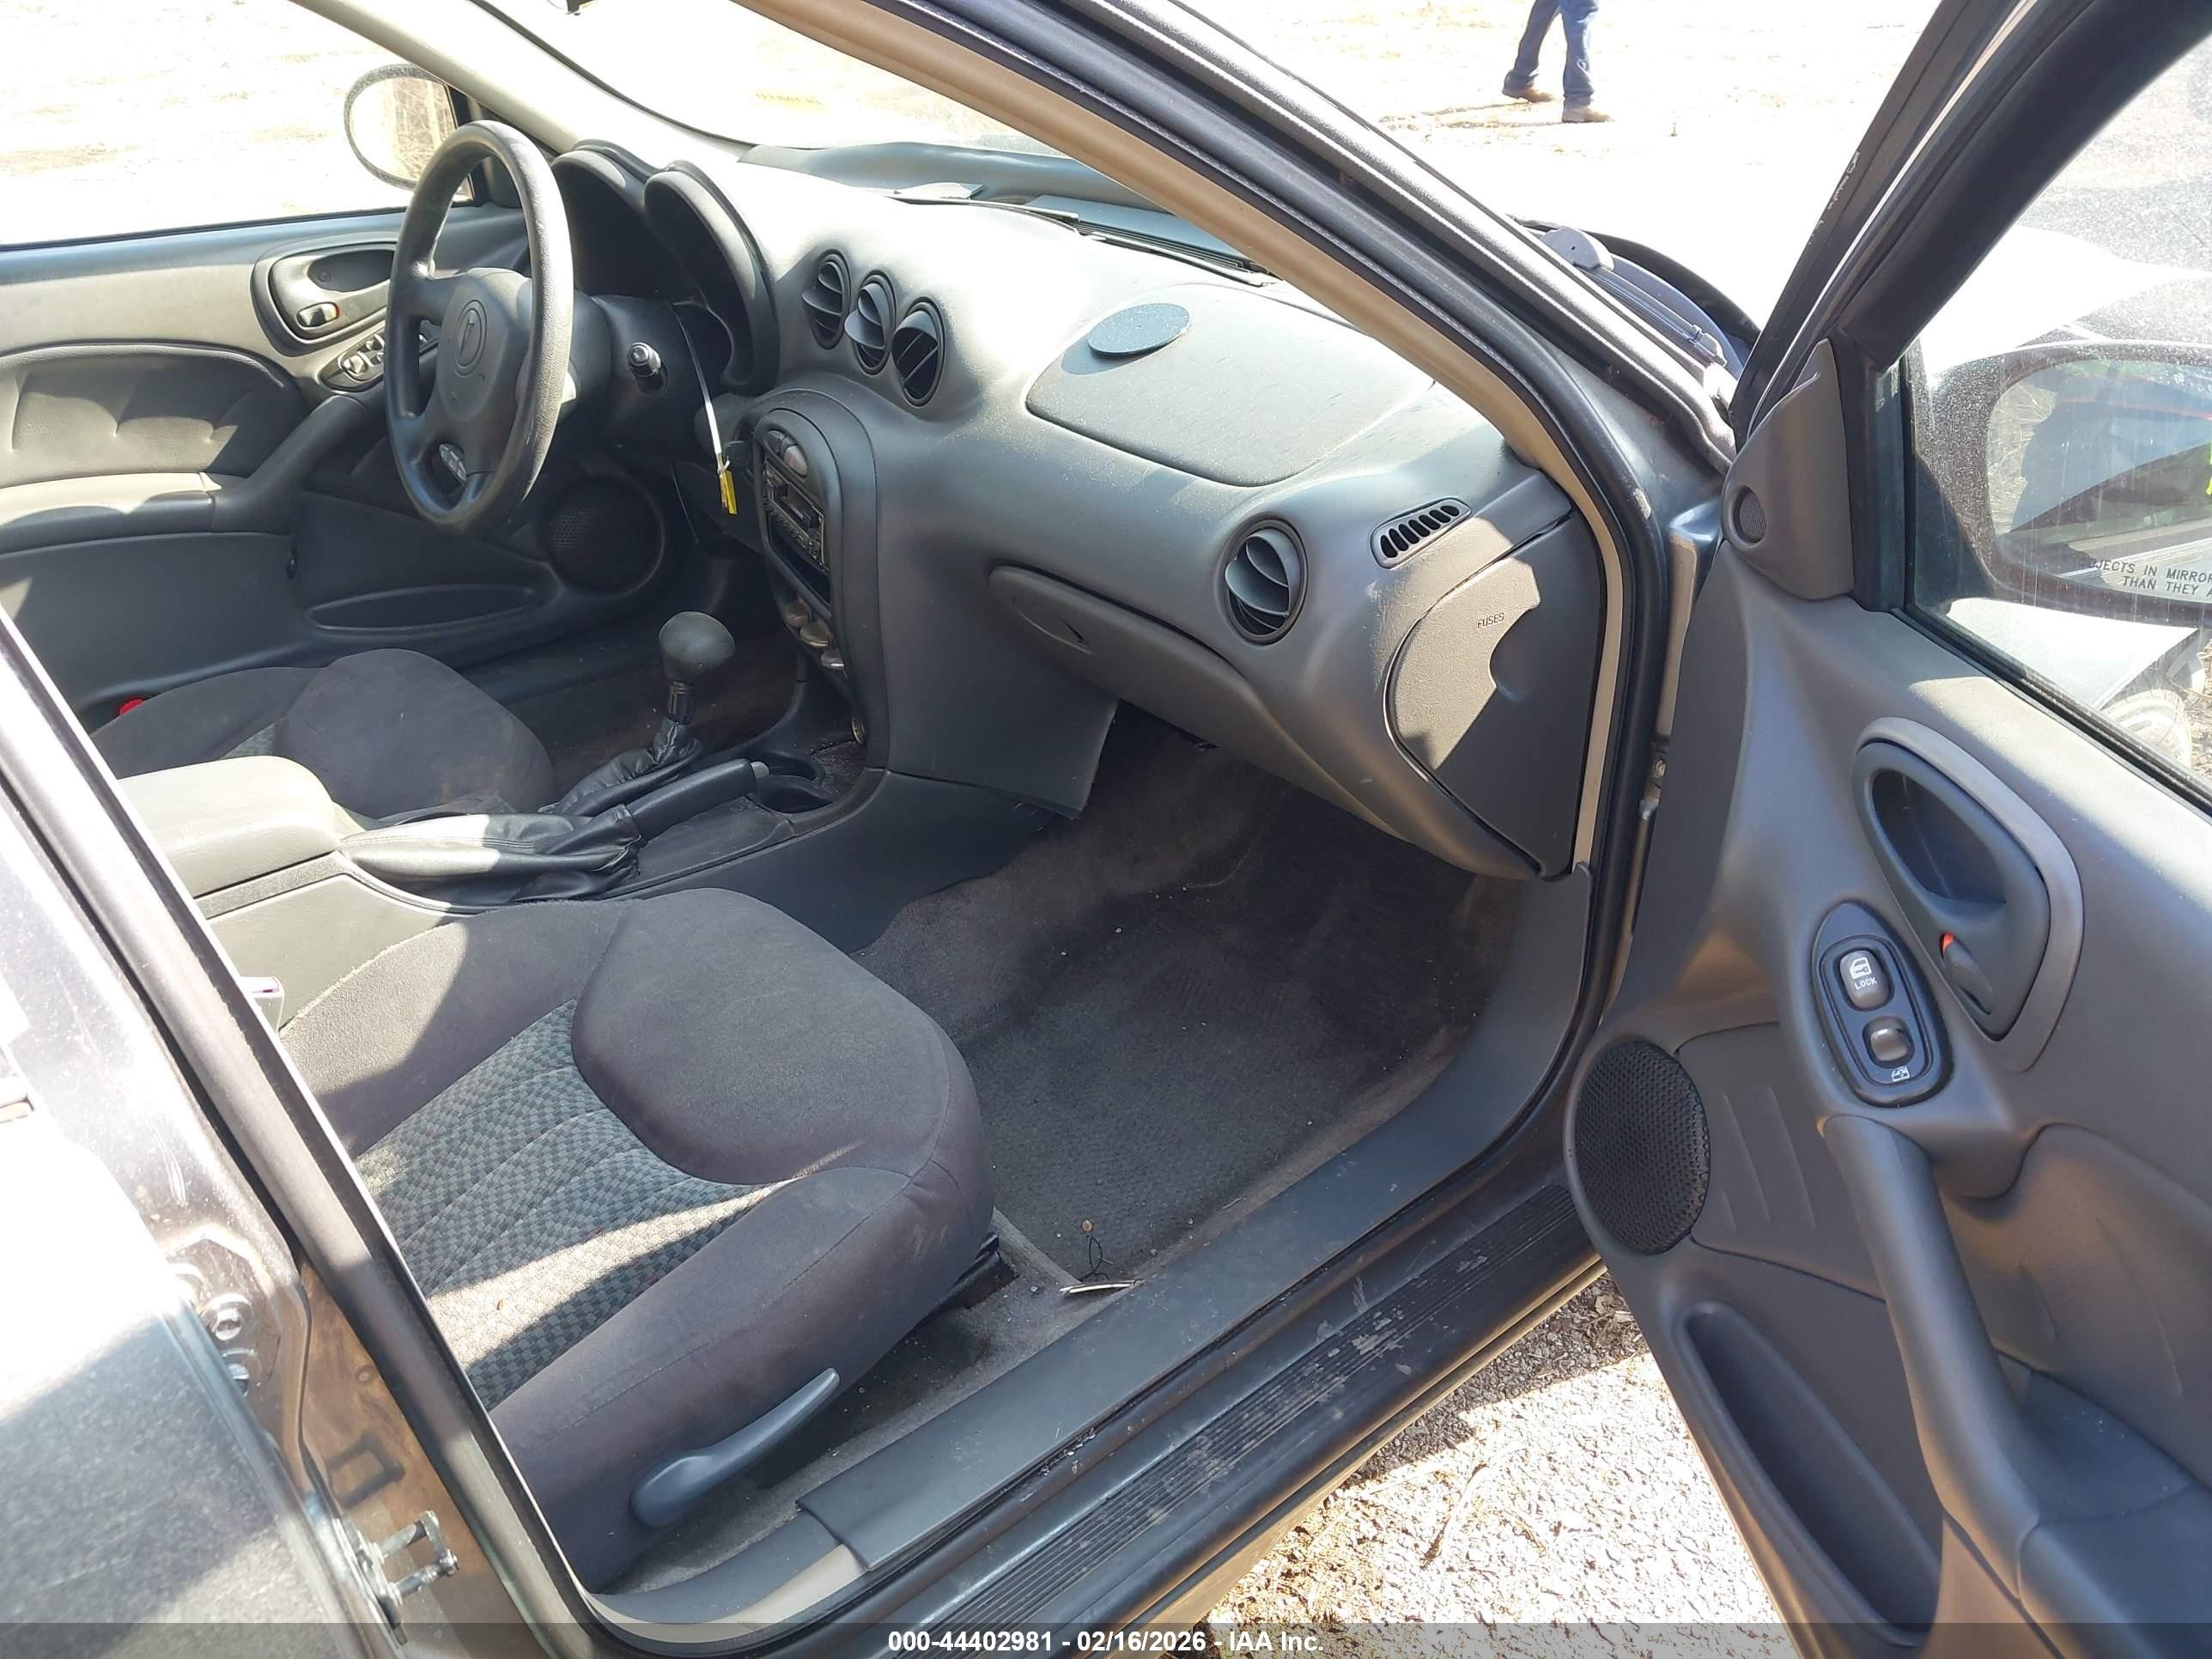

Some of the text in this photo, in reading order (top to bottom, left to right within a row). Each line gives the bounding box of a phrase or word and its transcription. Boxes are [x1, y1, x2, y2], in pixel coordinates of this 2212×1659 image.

[2143, 564, 2158, 576] IN
[2123, 575, 2157, 590] THAN
[2166, 580, 2199, 596] THEY
[1477, 612, 1505, 629] FUSES
[1854, 976, 1878, 990] LOCK
